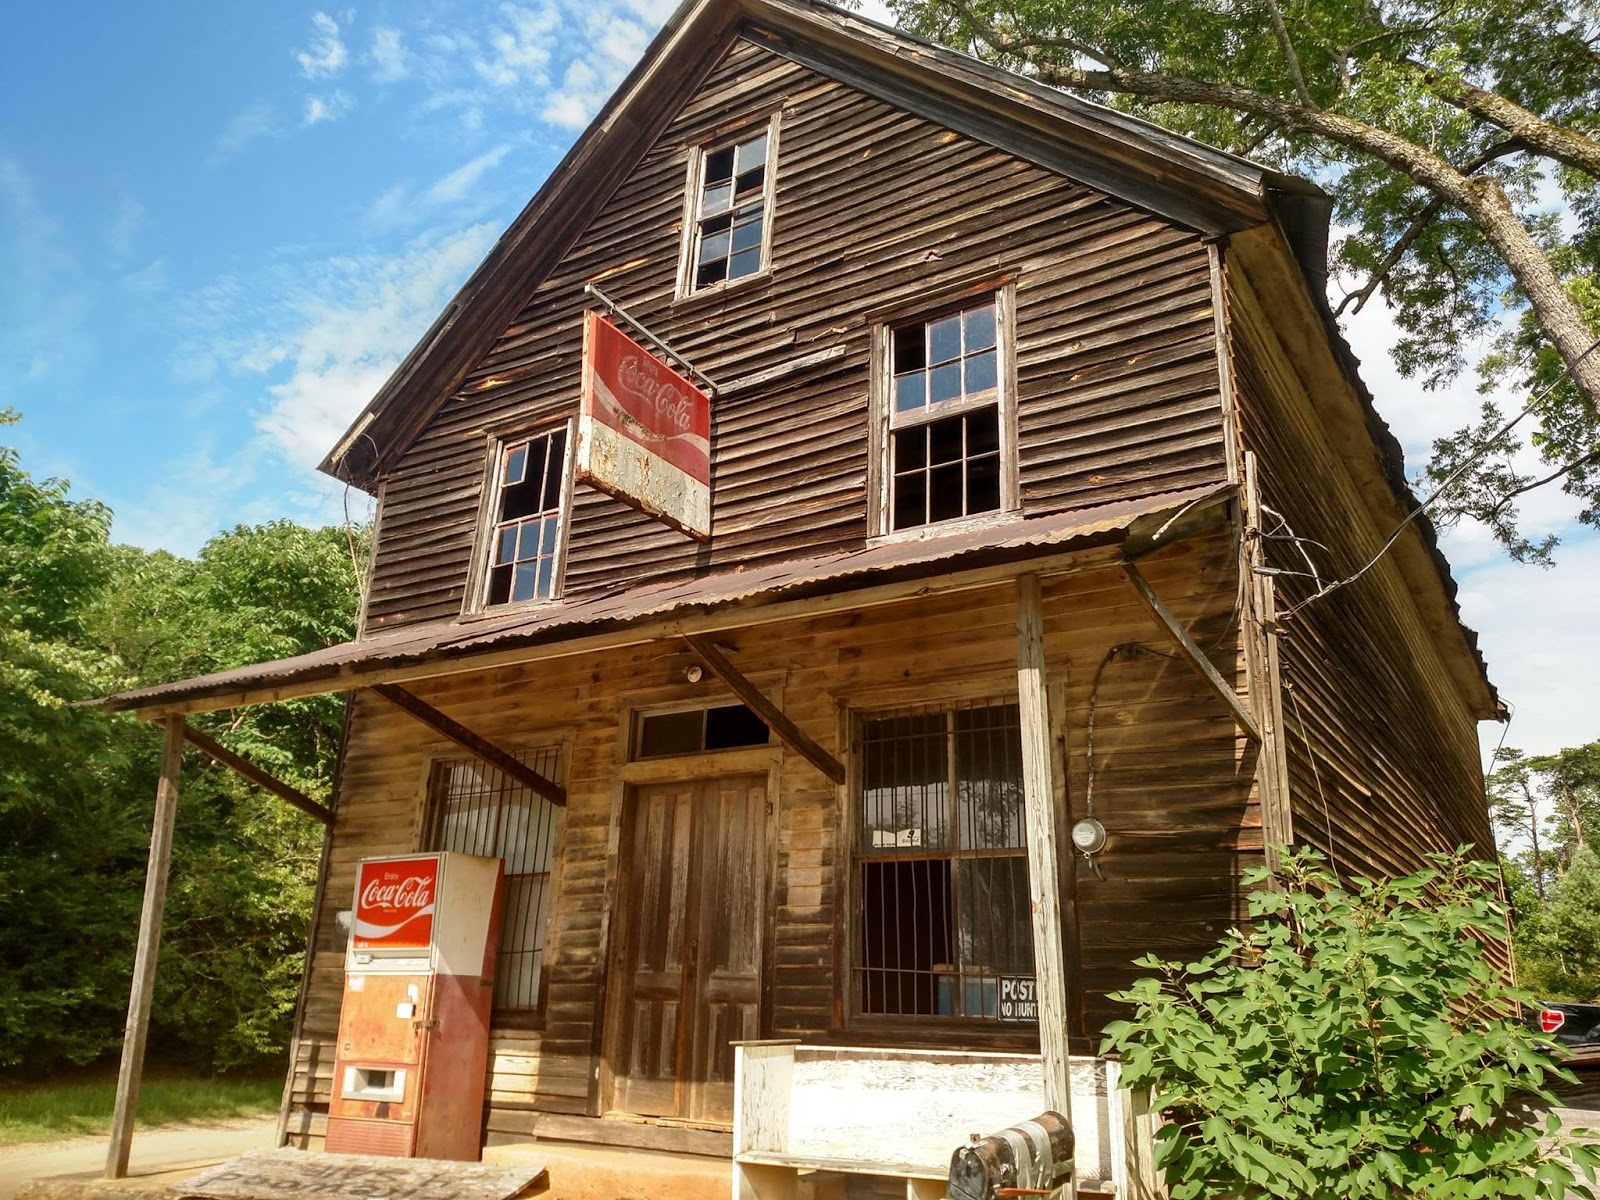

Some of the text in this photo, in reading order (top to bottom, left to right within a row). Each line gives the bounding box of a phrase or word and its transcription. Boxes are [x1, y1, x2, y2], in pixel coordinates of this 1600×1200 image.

[361, 876, 434, 910] Coca-Cola
[1001, 979, 1035, 1000] POST
[1014, 1002, 1037, 1017] HUNT
